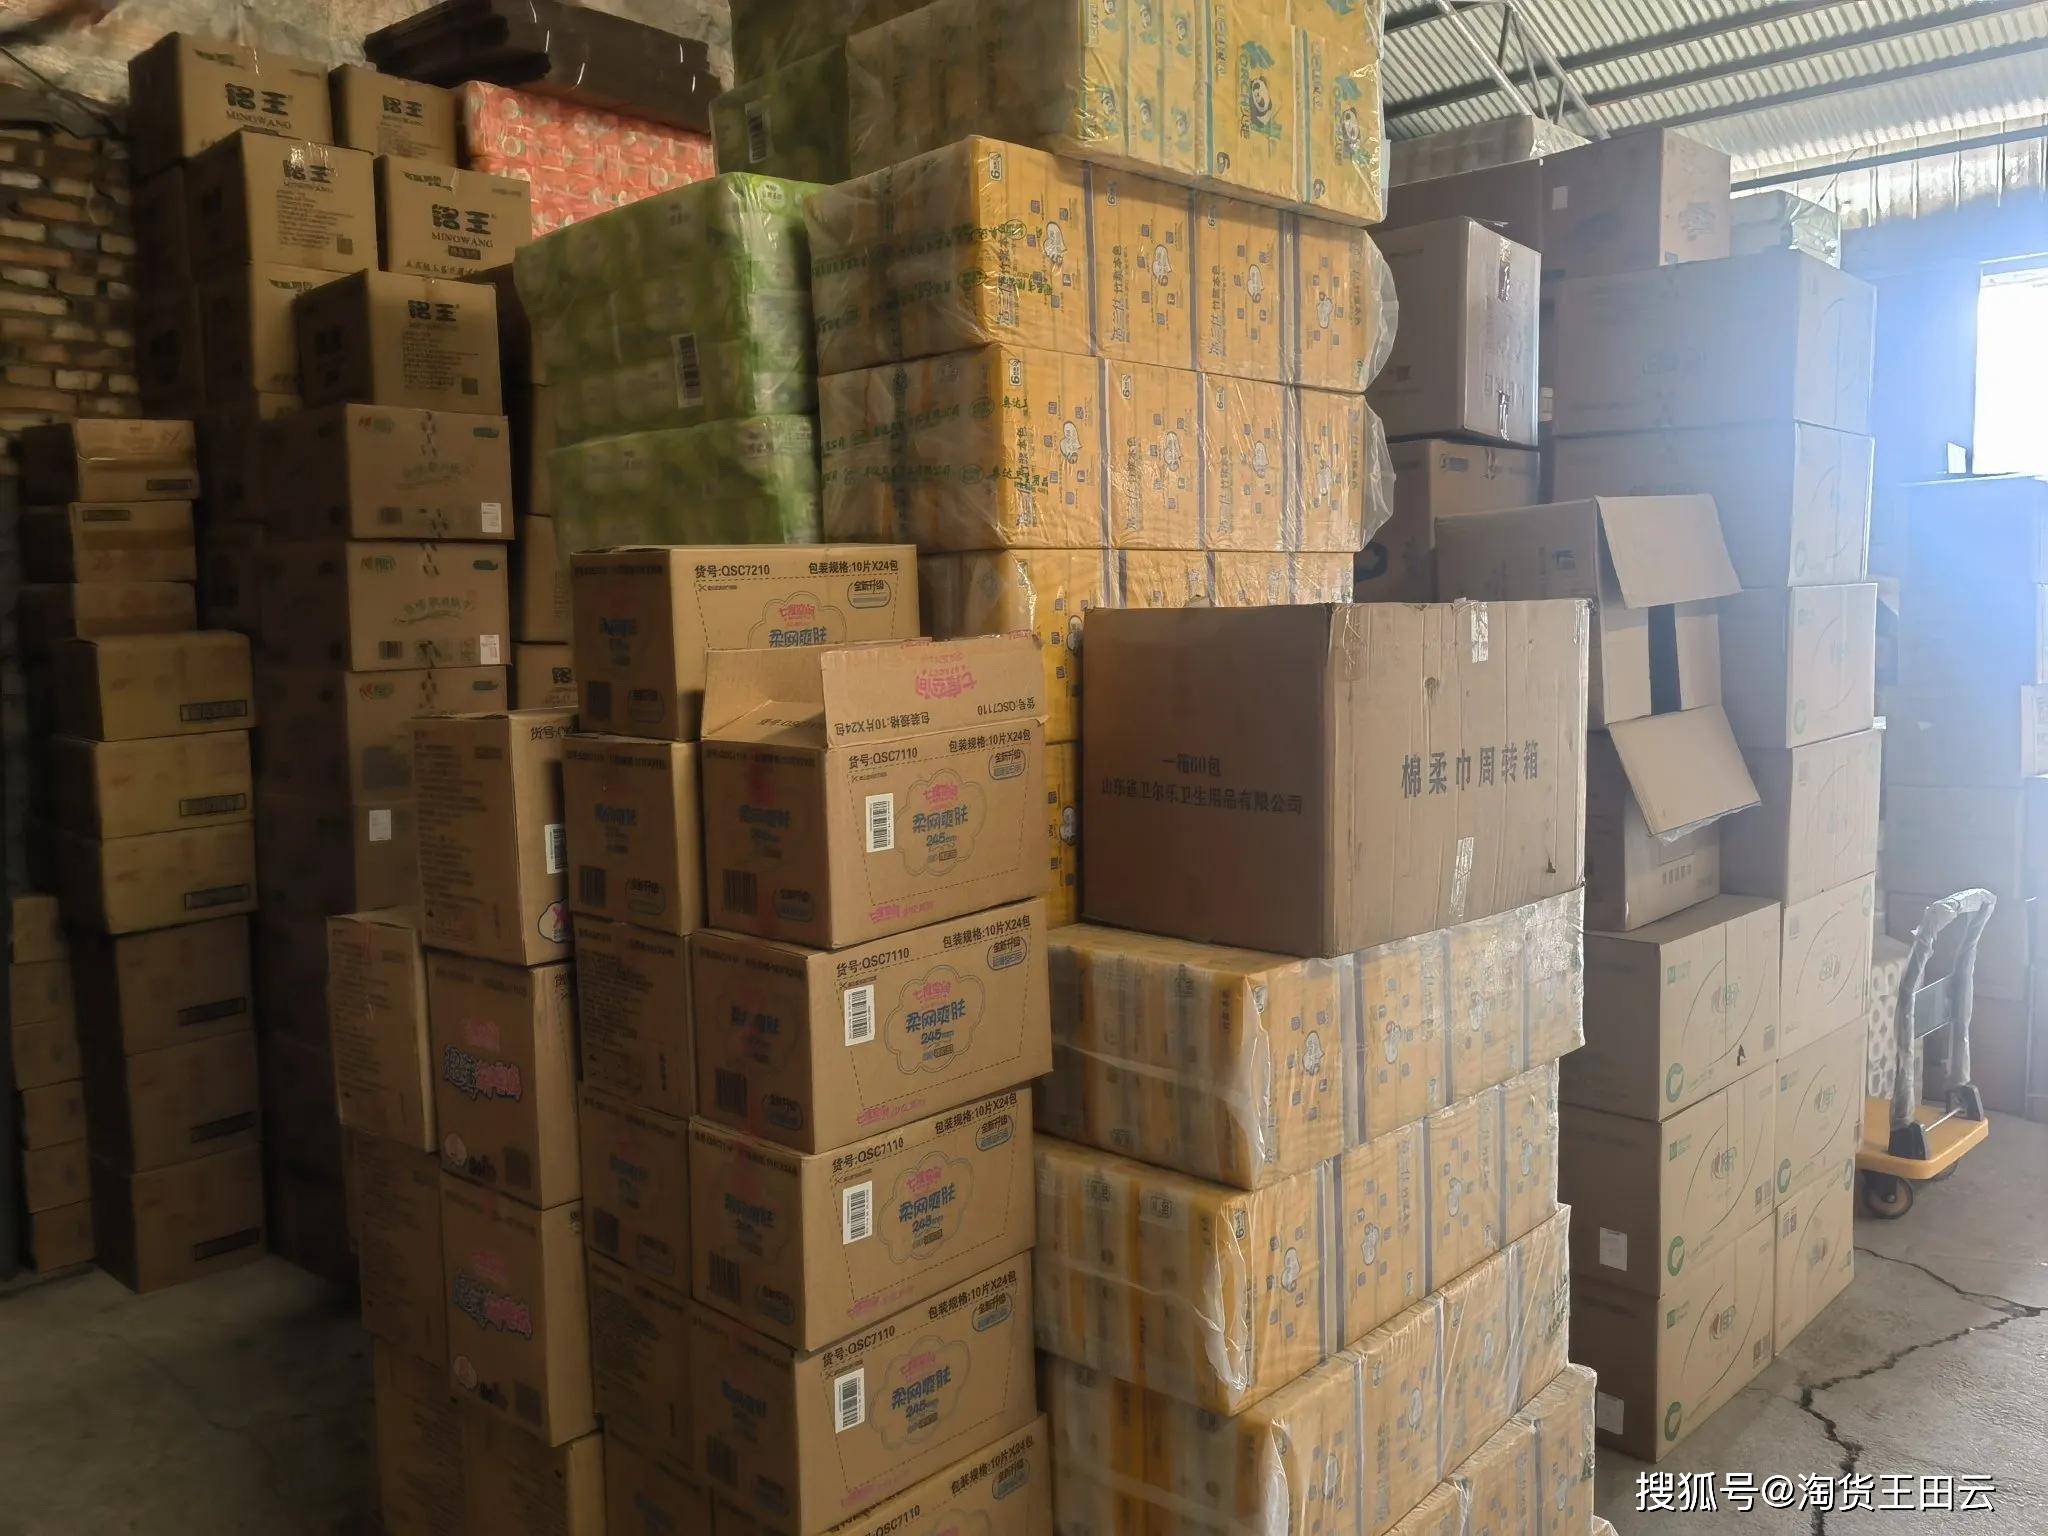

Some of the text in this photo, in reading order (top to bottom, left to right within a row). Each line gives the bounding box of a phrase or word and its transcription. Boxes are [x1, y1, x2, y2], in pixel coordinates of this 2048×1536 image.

[432, 232, 494, 248] MINGWANG
[694, 565, 770, 578] 货号:QSC7210
[977, 697, 1035, 715] 货号:QSC7110
[949, 728, 1031, 753] 包装规格:10片X24包
[849, 747, 918, 769] 货号:QSC7110
[1402, 740, 1538, 799] 棉柔巾周转箱
[943, 915, 1031, 949] 包装规格:10片X24包
[836, 947, 910, 977] 货号:QSC7110
[832, 1137, 904, 1173] 货号:QSC7110
[822, 1324, 896, 1368] 货号:QSC7110
